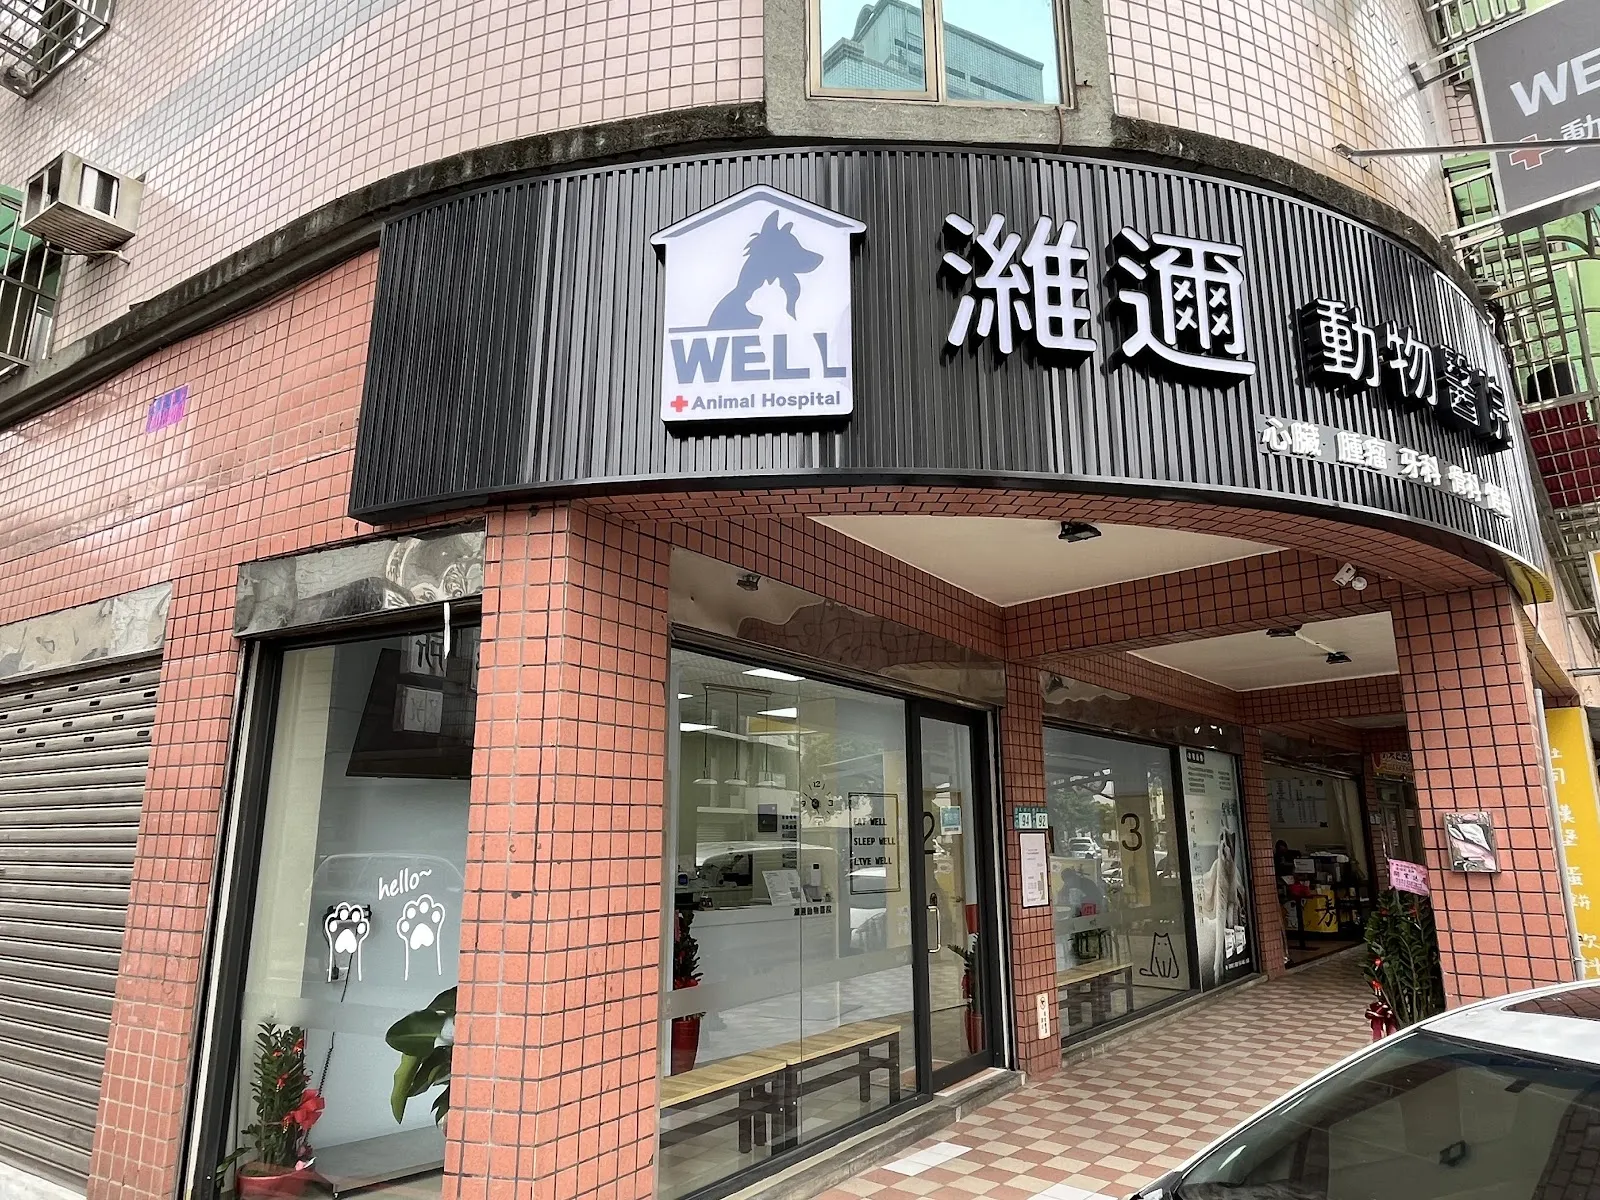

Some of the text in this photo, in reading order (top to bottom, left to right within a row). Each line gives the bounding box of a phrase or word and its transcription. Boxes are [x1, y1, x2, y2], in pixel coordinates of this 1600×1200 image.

[670, 332, 847, 384] WELL
[691, 391, 841, 411] Animal Hospital
[1261, 418, 1321, 456] 心臟
[1336, 431, 1387, 469] 腫瘤
[1399, 447, 1442, 486] 牙科
[870, 817, 888, 826] WELL
[1022, 814, 1030, 827] 94
[1039, 815, 1046, 827] 92
[1121, 813, 1142, 851] 3
[854, 837, 896, 846] SLEEP WELL
[854, 856, 892, 866] LIVE WELL
